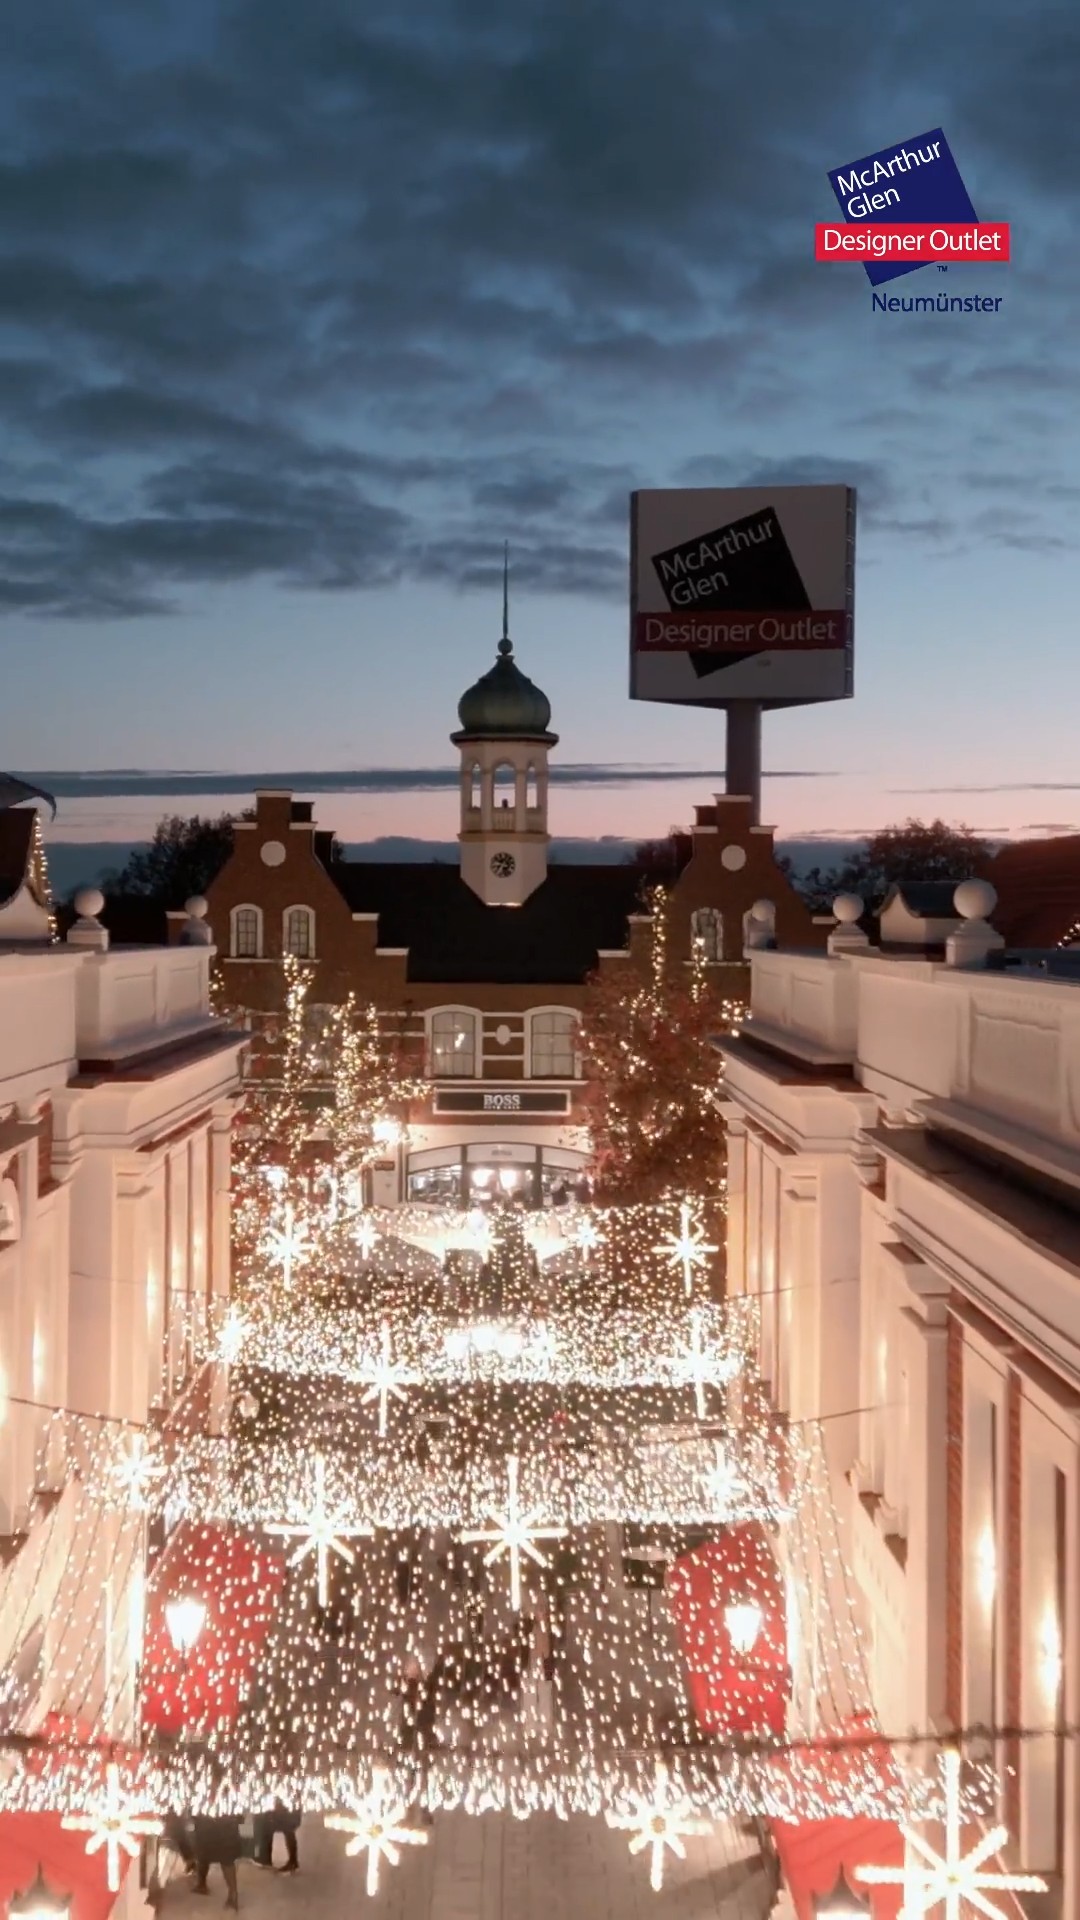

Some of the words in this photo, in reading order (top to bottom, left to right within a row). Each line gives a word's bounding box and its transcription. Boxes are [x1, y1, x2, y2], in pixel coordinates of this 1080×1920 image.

[659, 518, 774, 581] McArthur
[670, 572, 729, 605] Glen
[645, 618, 755, 648] Designer
[758, 617, 837, 642] Outlet
[483, 1094, 521, 1106] BOSS
